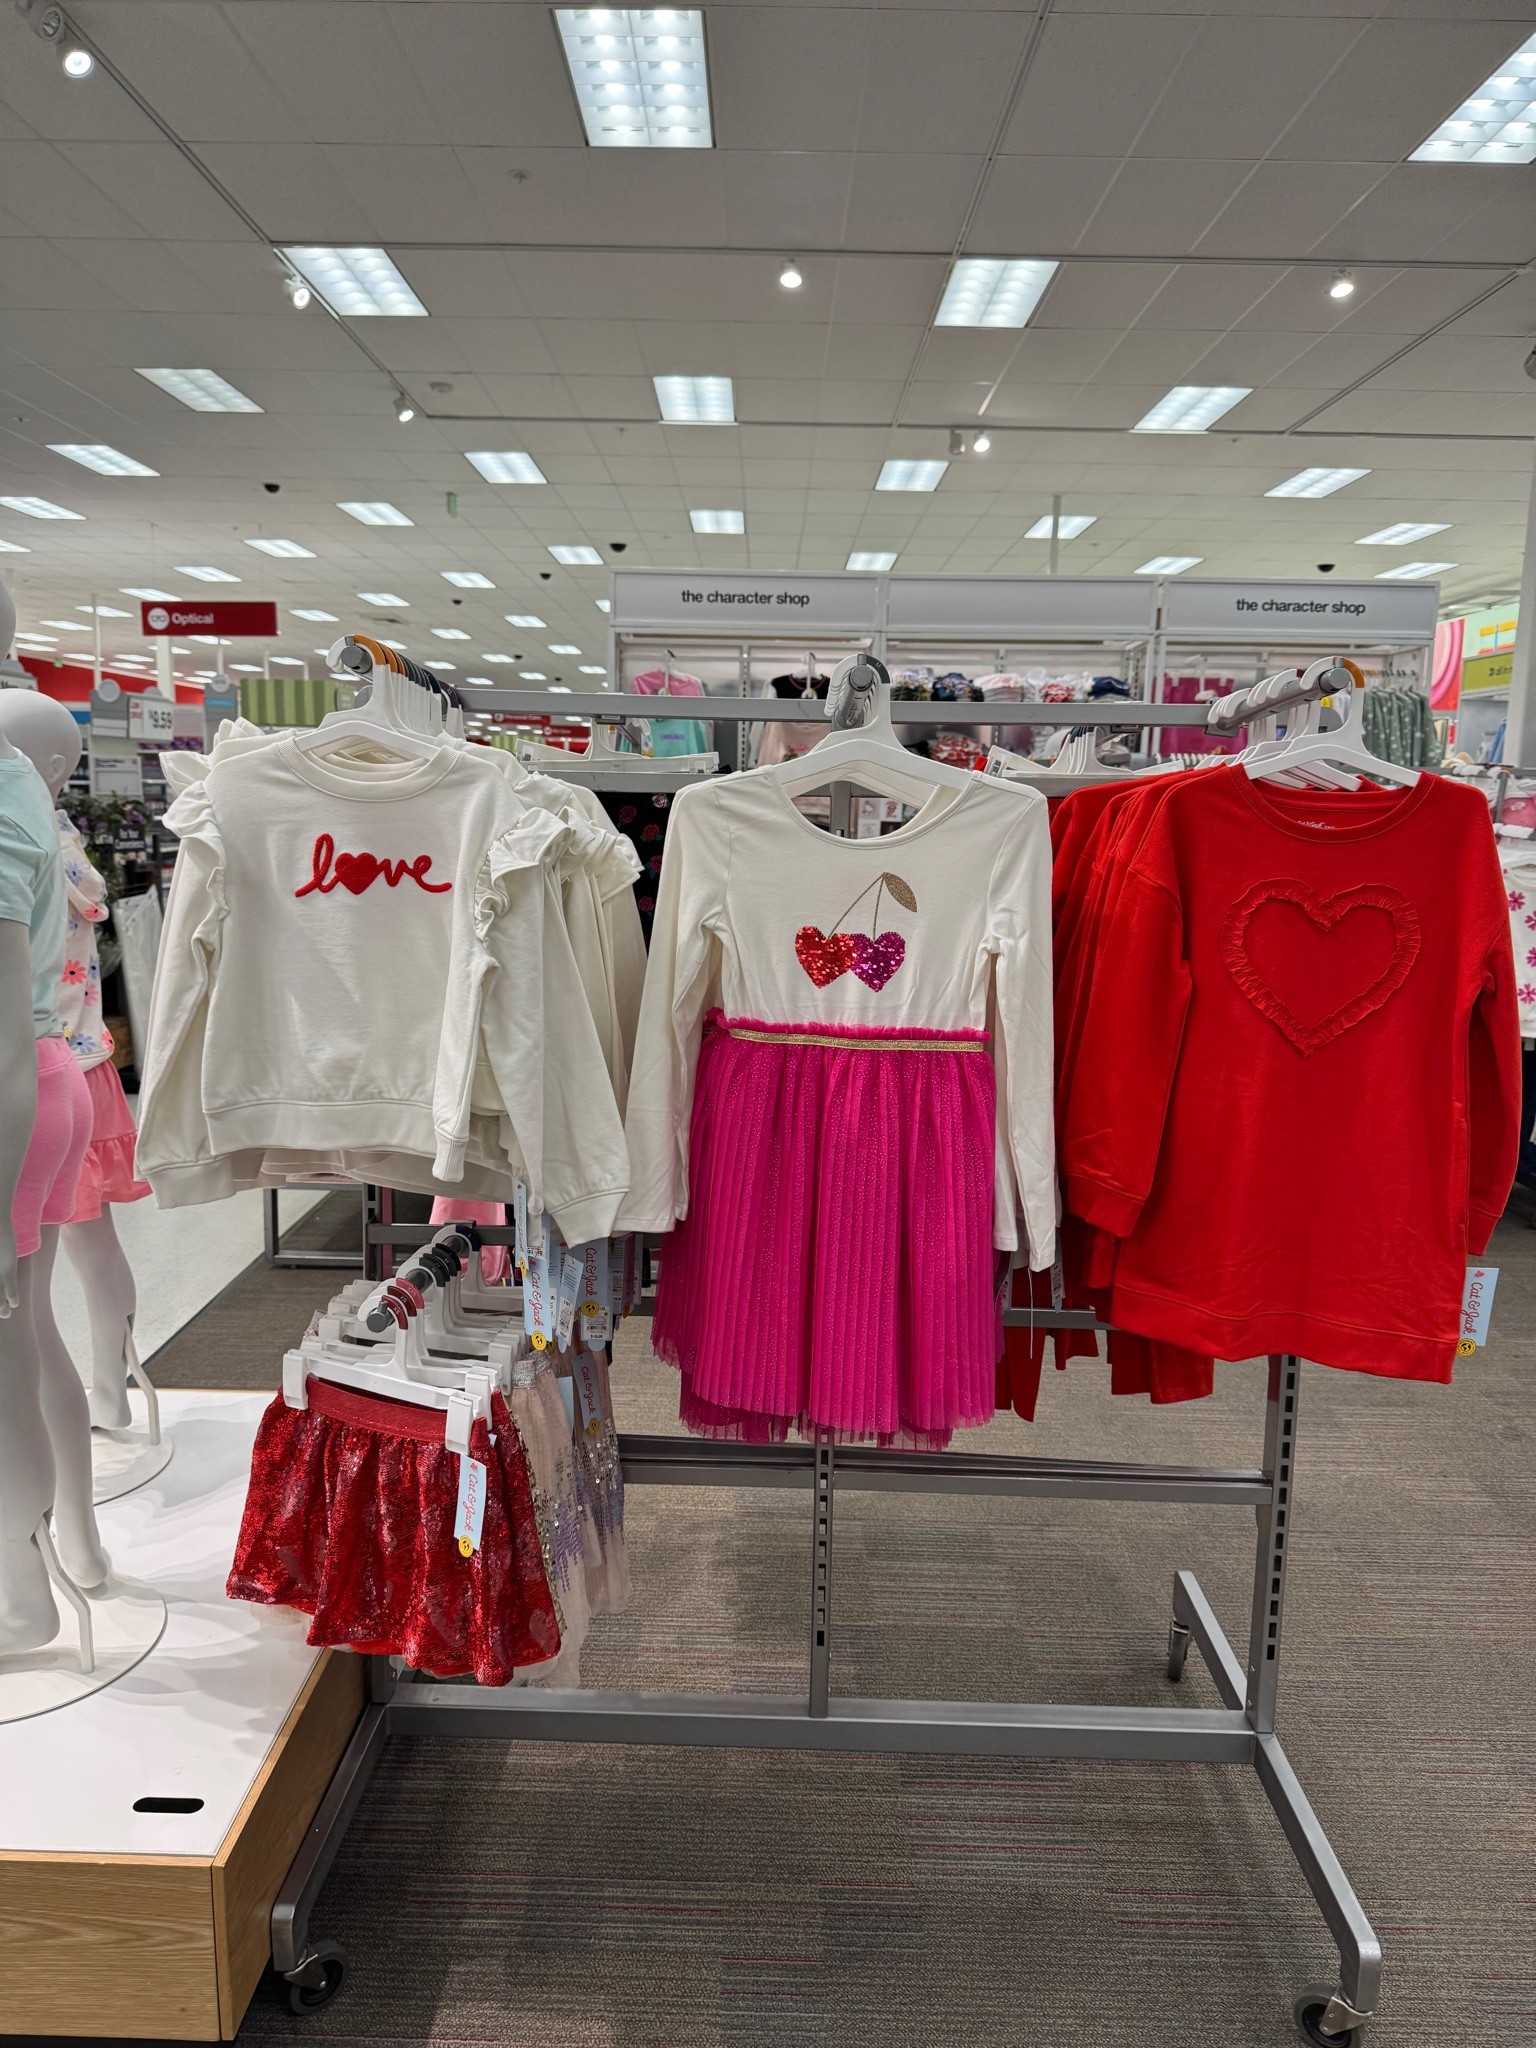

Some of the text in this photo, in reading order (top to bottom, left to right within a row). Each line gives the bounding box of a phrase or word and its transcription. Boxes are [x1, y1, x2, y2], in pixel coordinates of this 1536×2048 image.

[681, 590, 810, 608] the character shop
[1236, 598, 1366, 616] the character shop
[171, 612, 214, 626] Optical
[582, 1247, 598, 1297] Cat & Jack
[528, 1271, 544, 1326] Cat & Jack
[1461, 1282, 1484, 1335] Cat & Jack
[582, 1366, 590, 1382] Cat
[584, 1392, 596, 1414] Jack
[462, 1473, 478, 1532] Cat & Jack
